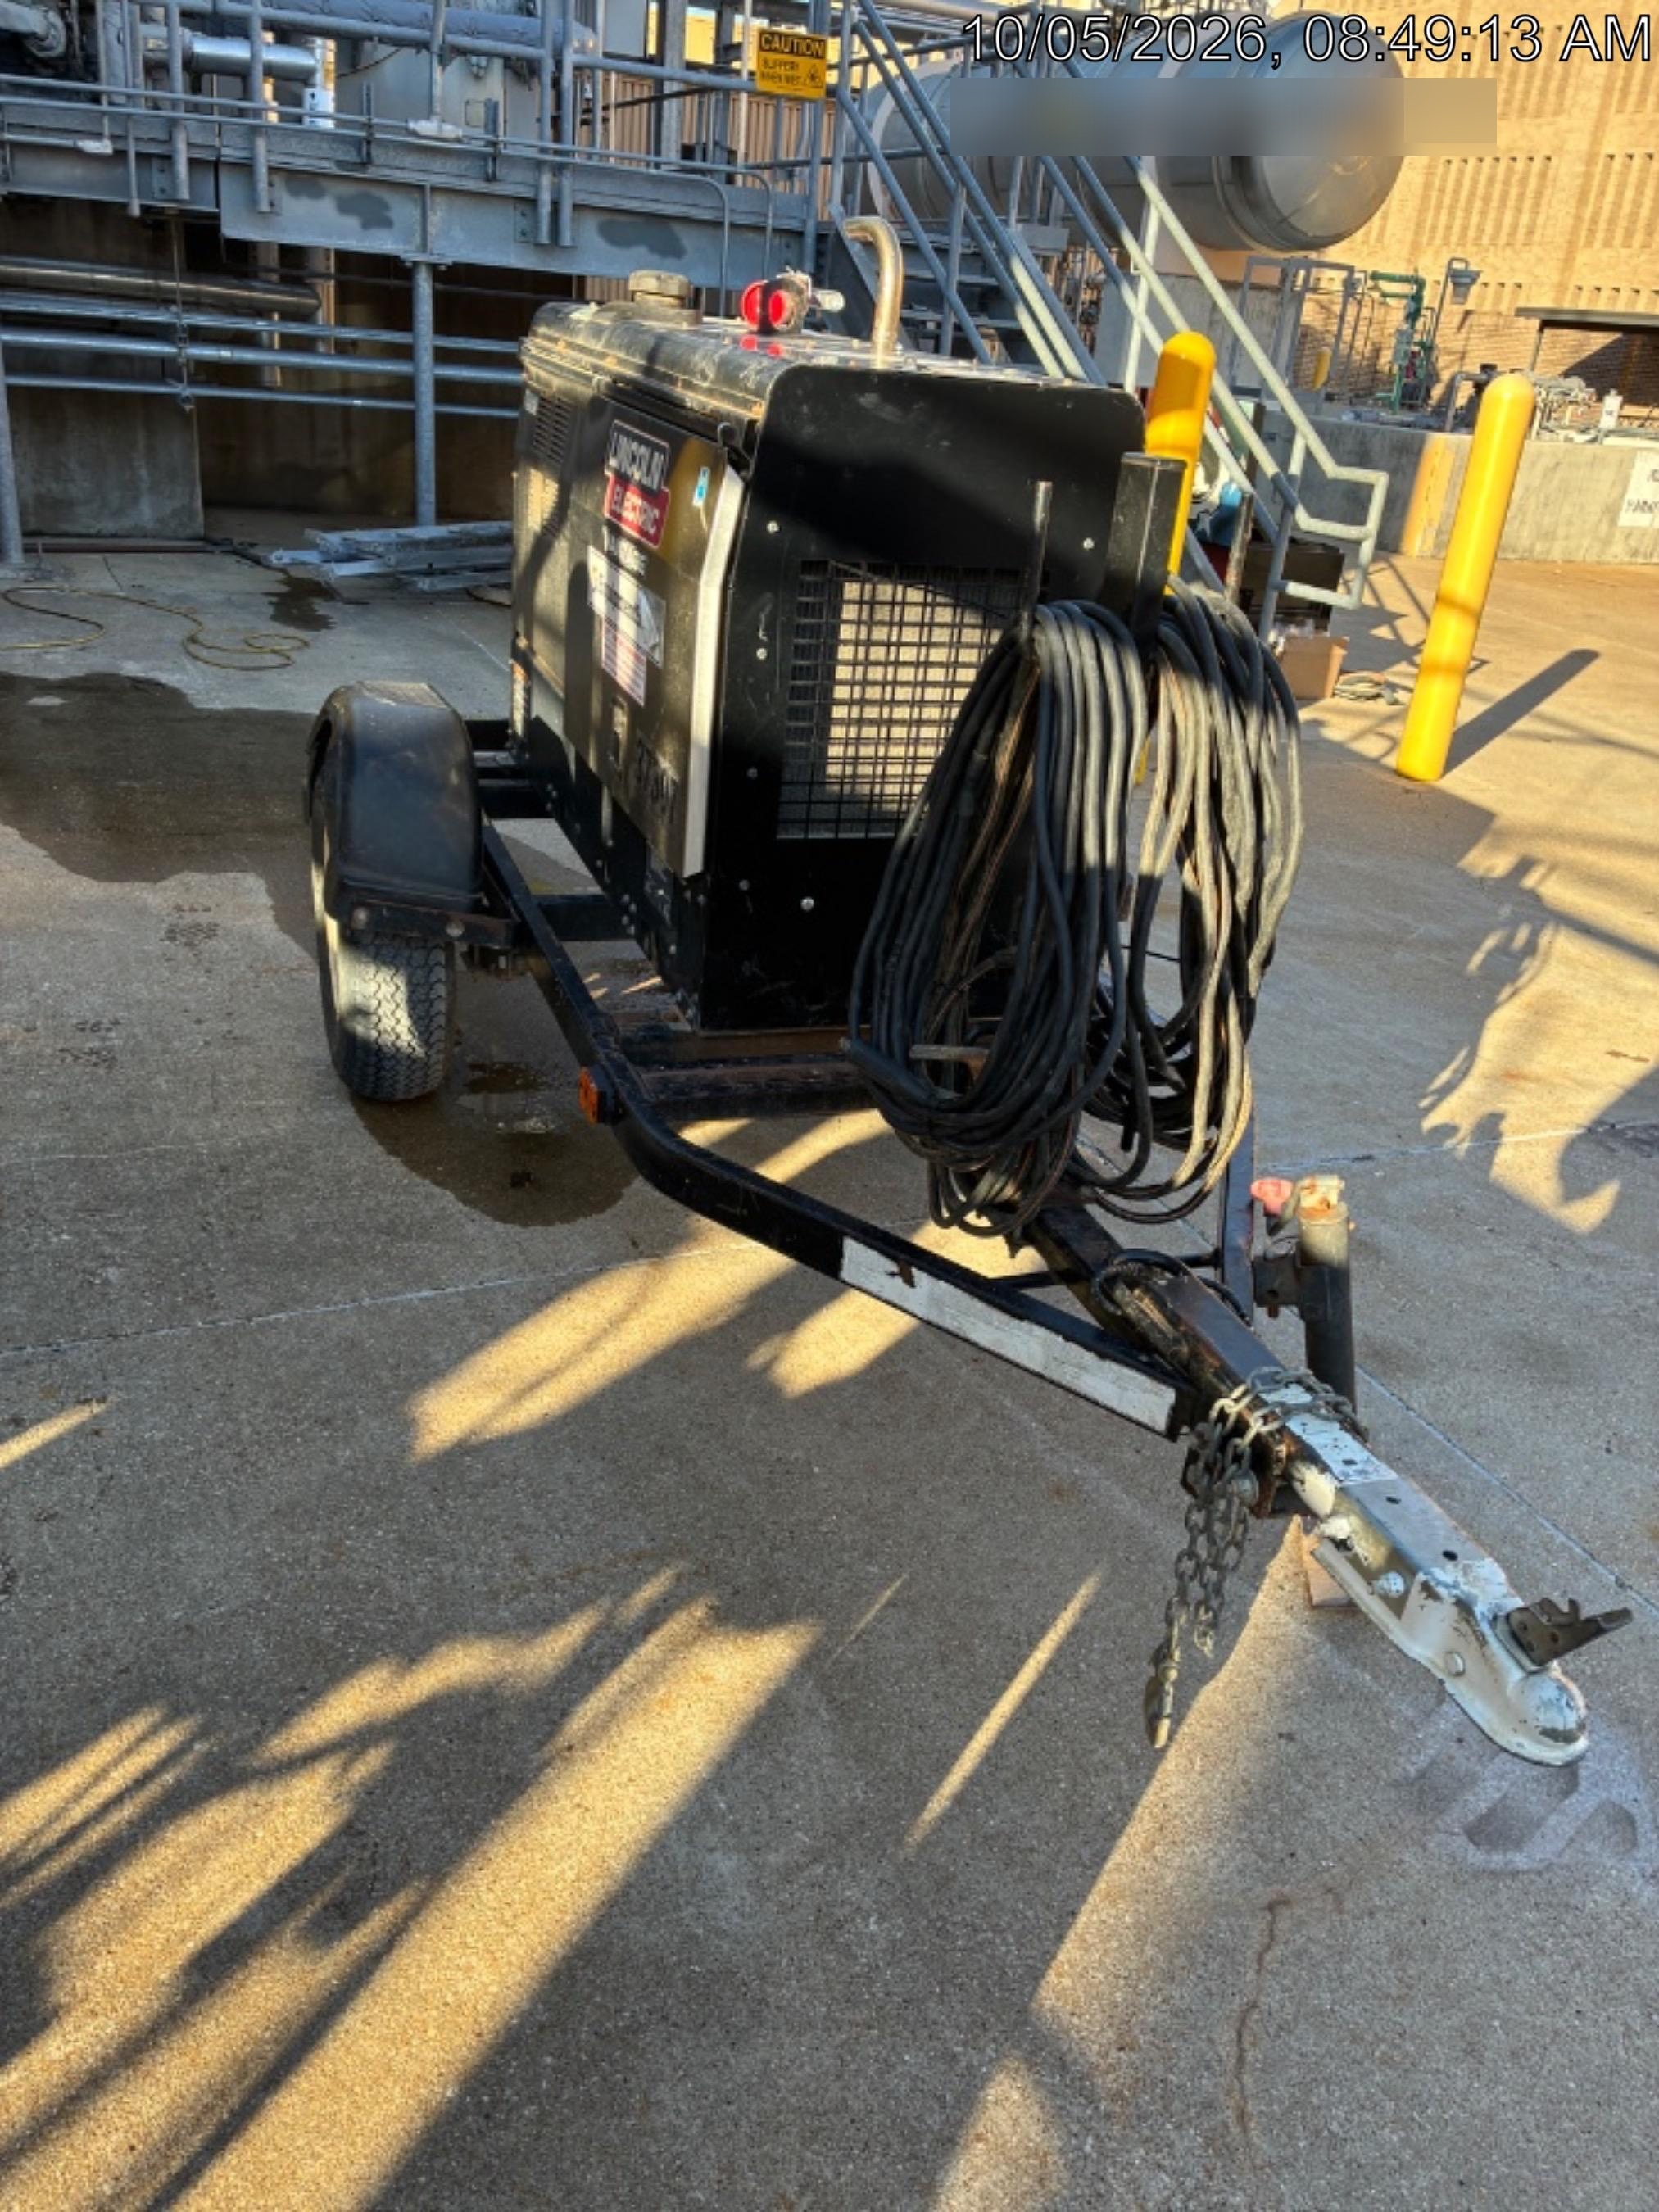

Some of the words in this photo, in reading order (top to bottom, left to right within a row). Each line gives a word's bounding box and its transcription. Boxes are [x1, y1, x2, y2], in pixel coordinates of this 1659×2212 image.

[762, 34, 824, 59] CAUTION
[609, 431, 664, 491] LINCOLN
[611, 484, 660, 536] ELECTRIC
